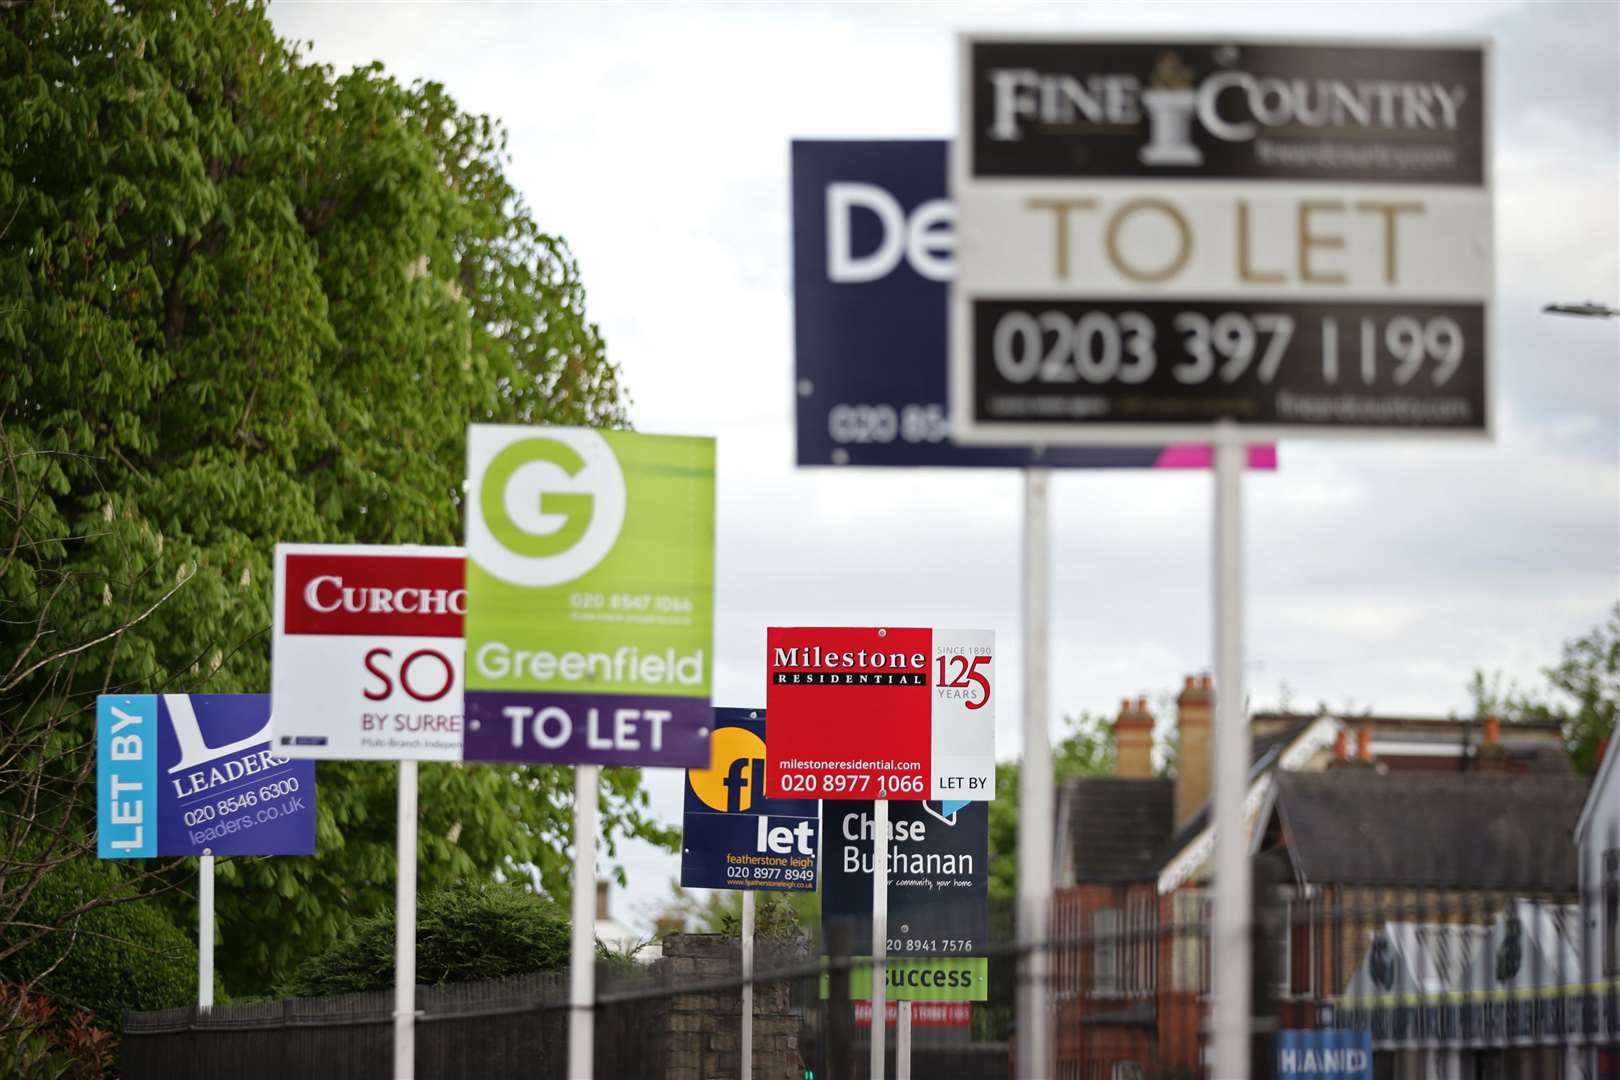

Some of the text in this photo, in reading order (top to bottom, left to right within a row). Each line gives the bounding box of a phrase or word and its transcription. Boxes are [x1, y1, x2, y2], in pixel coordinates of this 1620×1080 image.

[1025, 197, 1425, 288] TO LET
[993, 311, 1465, 387] 0203 397 1199
[828, 404, 899, 443] 020
[480, 436, 595, 558] G
[773, 646, 927, 669] Milestone
[936, 646, 992, 656] SINCE 1890
[475, 641, 705, 686] Greenfield
[777, 673, 922, 685] RESIDENTIAL
[936, 655, 993, 710] 125
[938, 689, 977, 699] YEARS
[362, 713, 464, 732] BY SURRE
[503, 706, 672, 751] TO LET
[779, 758, 921, 771] milestoneresidential.com
[111, 705, 144, 849] LET BY
[780, 774, 924, 793] 020 8977 1066
[939, 777, 988, 790] LET BY
[183, 776, 300, 827] 020 8546 6300
[188, 795, 306, 846] leaders.co.uk
[726, 852, 814, 869] featherstone leigh
[843, 845, 973, 875] Buhanan
[726, 866, 814, 882] 020 8977 8949
[895, 877, 933, 891] community,
[936, 880, 951, 891] your
[953, 878, 973, 888] home
[906, 939, 937, 952] 8941
[941, 940, 973, 952] 7576
